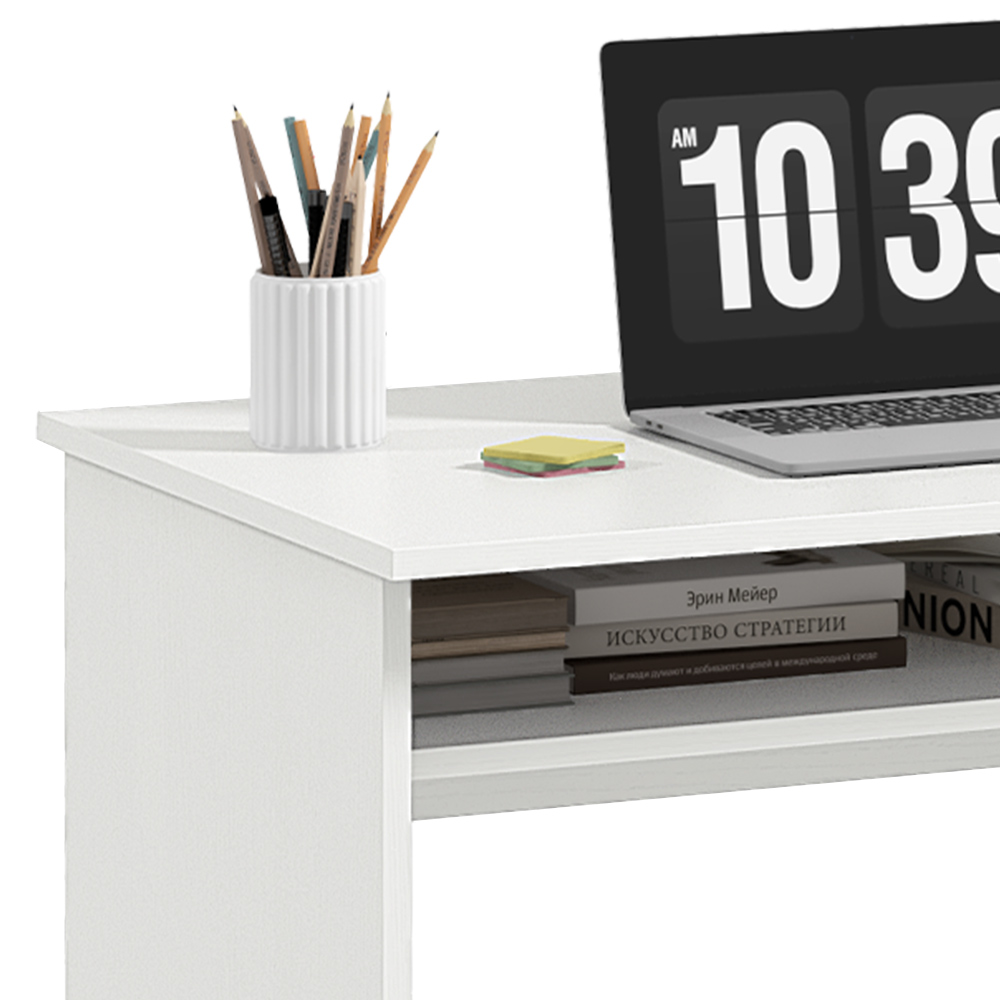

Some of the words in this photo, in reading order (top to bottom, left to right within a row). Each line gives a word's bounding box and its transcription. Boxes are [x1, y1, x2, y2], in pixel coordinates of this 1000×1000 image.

[671, 126, 698, 149] AM
[680, 120, 841, 310] 10
[686, 590, 724, 610] Эрин
[728, 585, 779, 604] Мейер
[606, 623, 728, 647] ИСКУССТВО
[733, 615, 847, 638] СТРАТЕГИИ
[609, 671, 625, 682] Как
[626, 670, 650, 680] люди
[651, 667, 684, 679] думают
[693, 662, 745, 675] добиваются
[746, 659, 773, 670] целей
[781, 652, 851, 666] международной
[852, 651, 878, 662] среде
